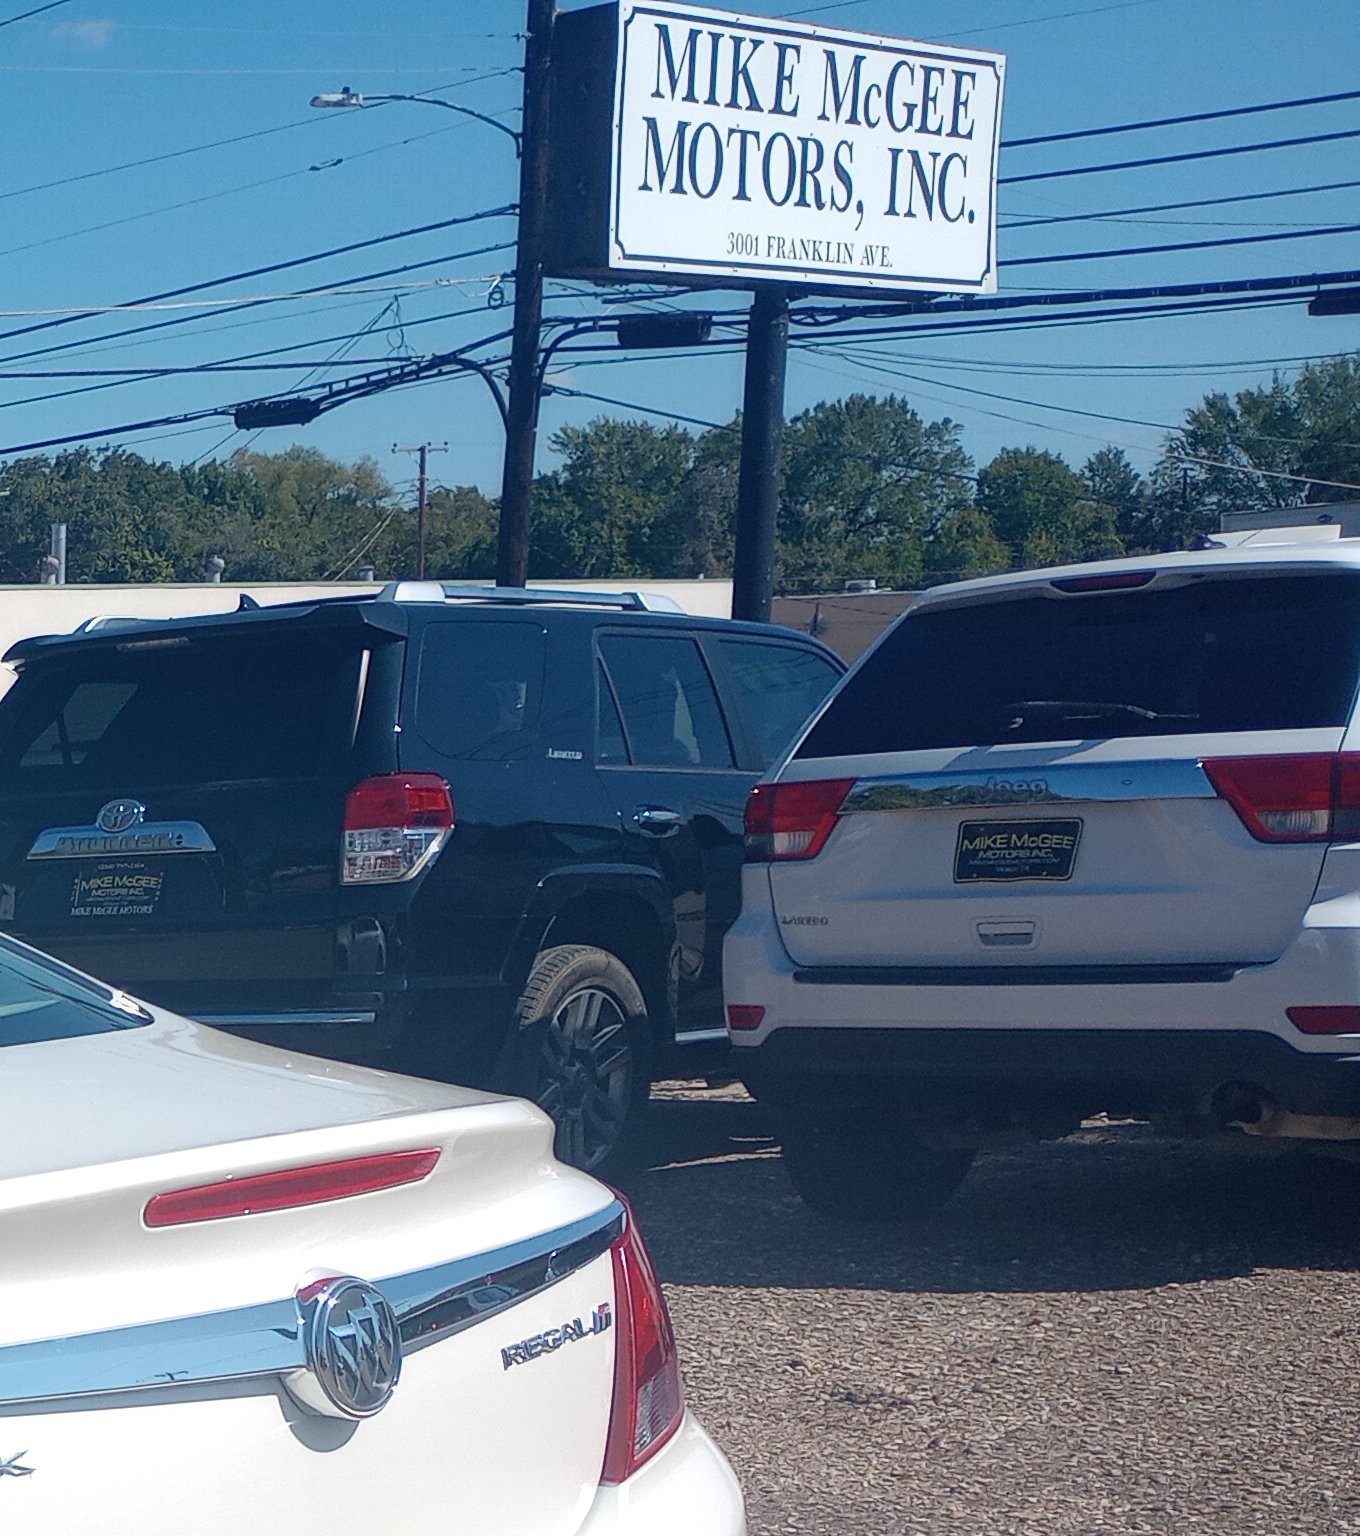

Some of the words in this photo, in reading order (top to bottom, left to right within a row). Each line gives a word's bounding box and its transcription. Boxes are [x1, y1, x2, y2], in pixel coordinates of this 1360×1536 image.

[651, 23, 801, 117] MIKE
[817, 49, 976, 140] McGEE
[638, 116, 864, 231] MOTORS,
[884, 147, 975, 224] INC.
[726, 232, 760, 257] 3001
[766, 235, 855, 264] FRANKLIN
[860, 243, 894, 267] AVE.
[962, 834, 1008, 851] MIKE
[1010, 832, 1075, 848] McGEE
[81, 875, 113, 891] MIKE
[114, 875, 160, 888] McGEE
[500, 1317, 592, 1370] REGAL
